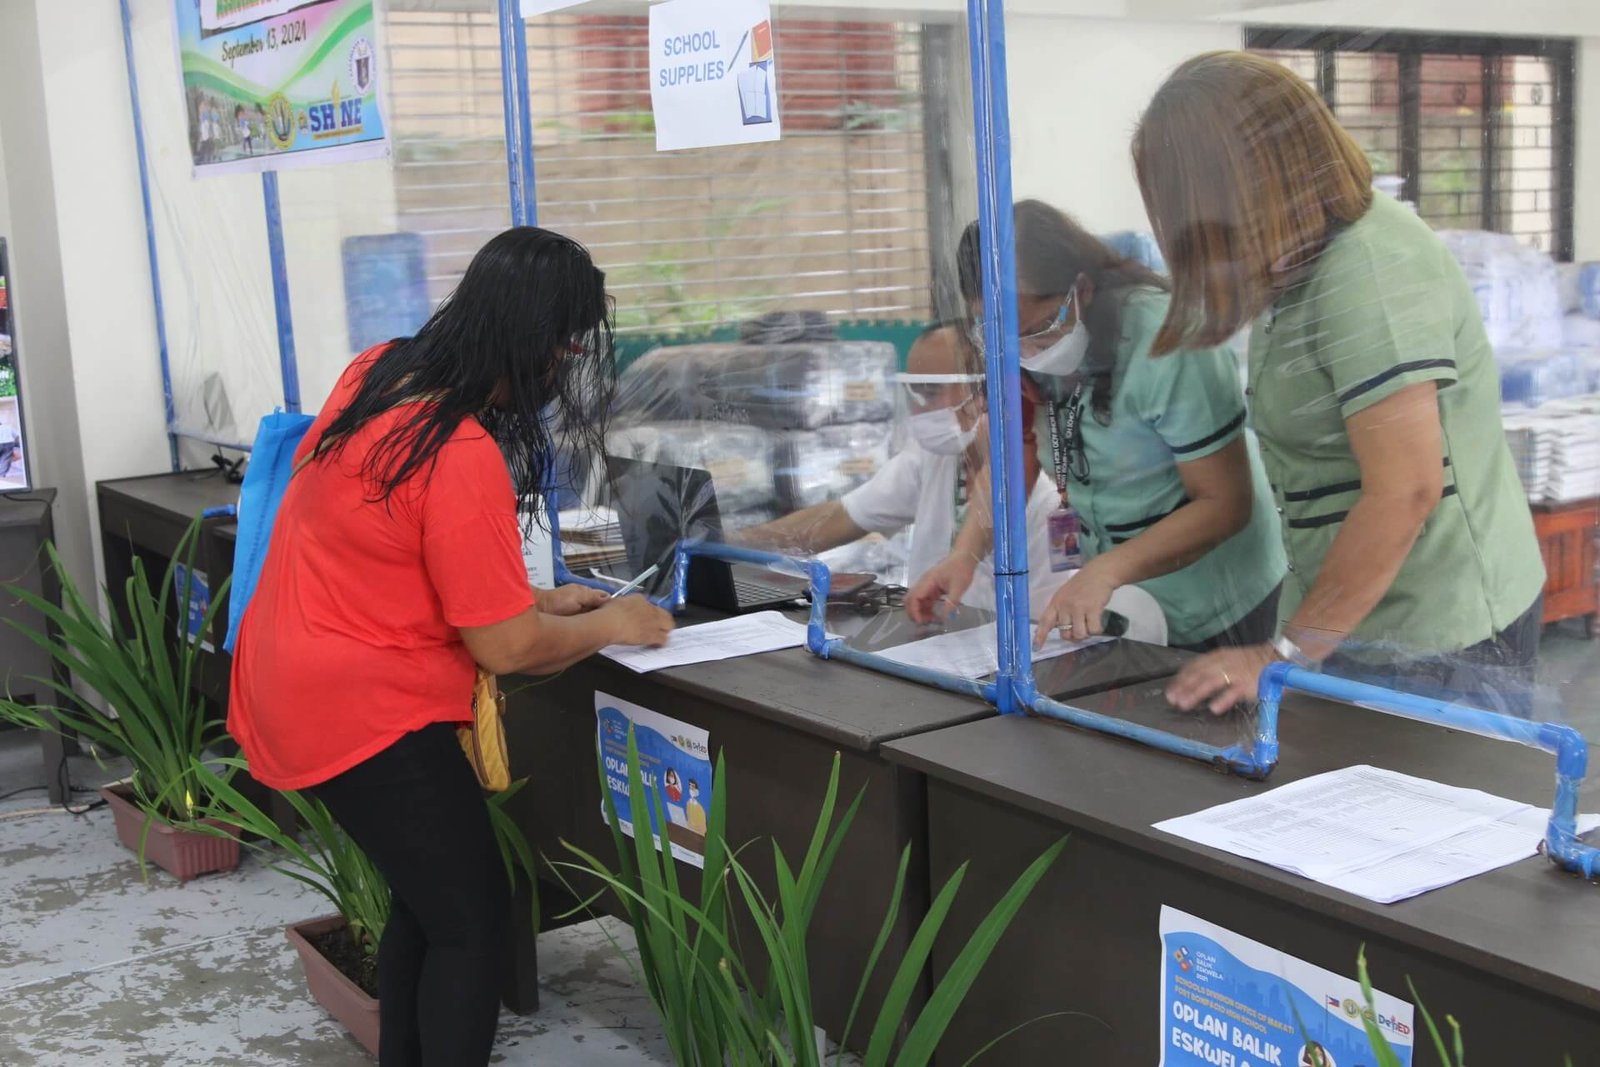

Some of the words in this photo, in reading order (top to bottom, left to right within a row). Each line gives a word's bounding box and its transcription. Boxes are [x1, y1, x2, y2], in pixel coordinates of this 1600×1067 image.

[221, 33, 264, 69] September
[281, 19, 307, 46] 2021
[664, 30, 721, 57] SCHOOL
[659, 60, 724, 87] SUPPLIES
[605, 756, 628, 777] OPLAN
[1173, 1000, 1228, 1041] OPLAN
[1232, 1026, 1281, 1067] BALIK
[1378, 1013, 1411, 1035] DepED
